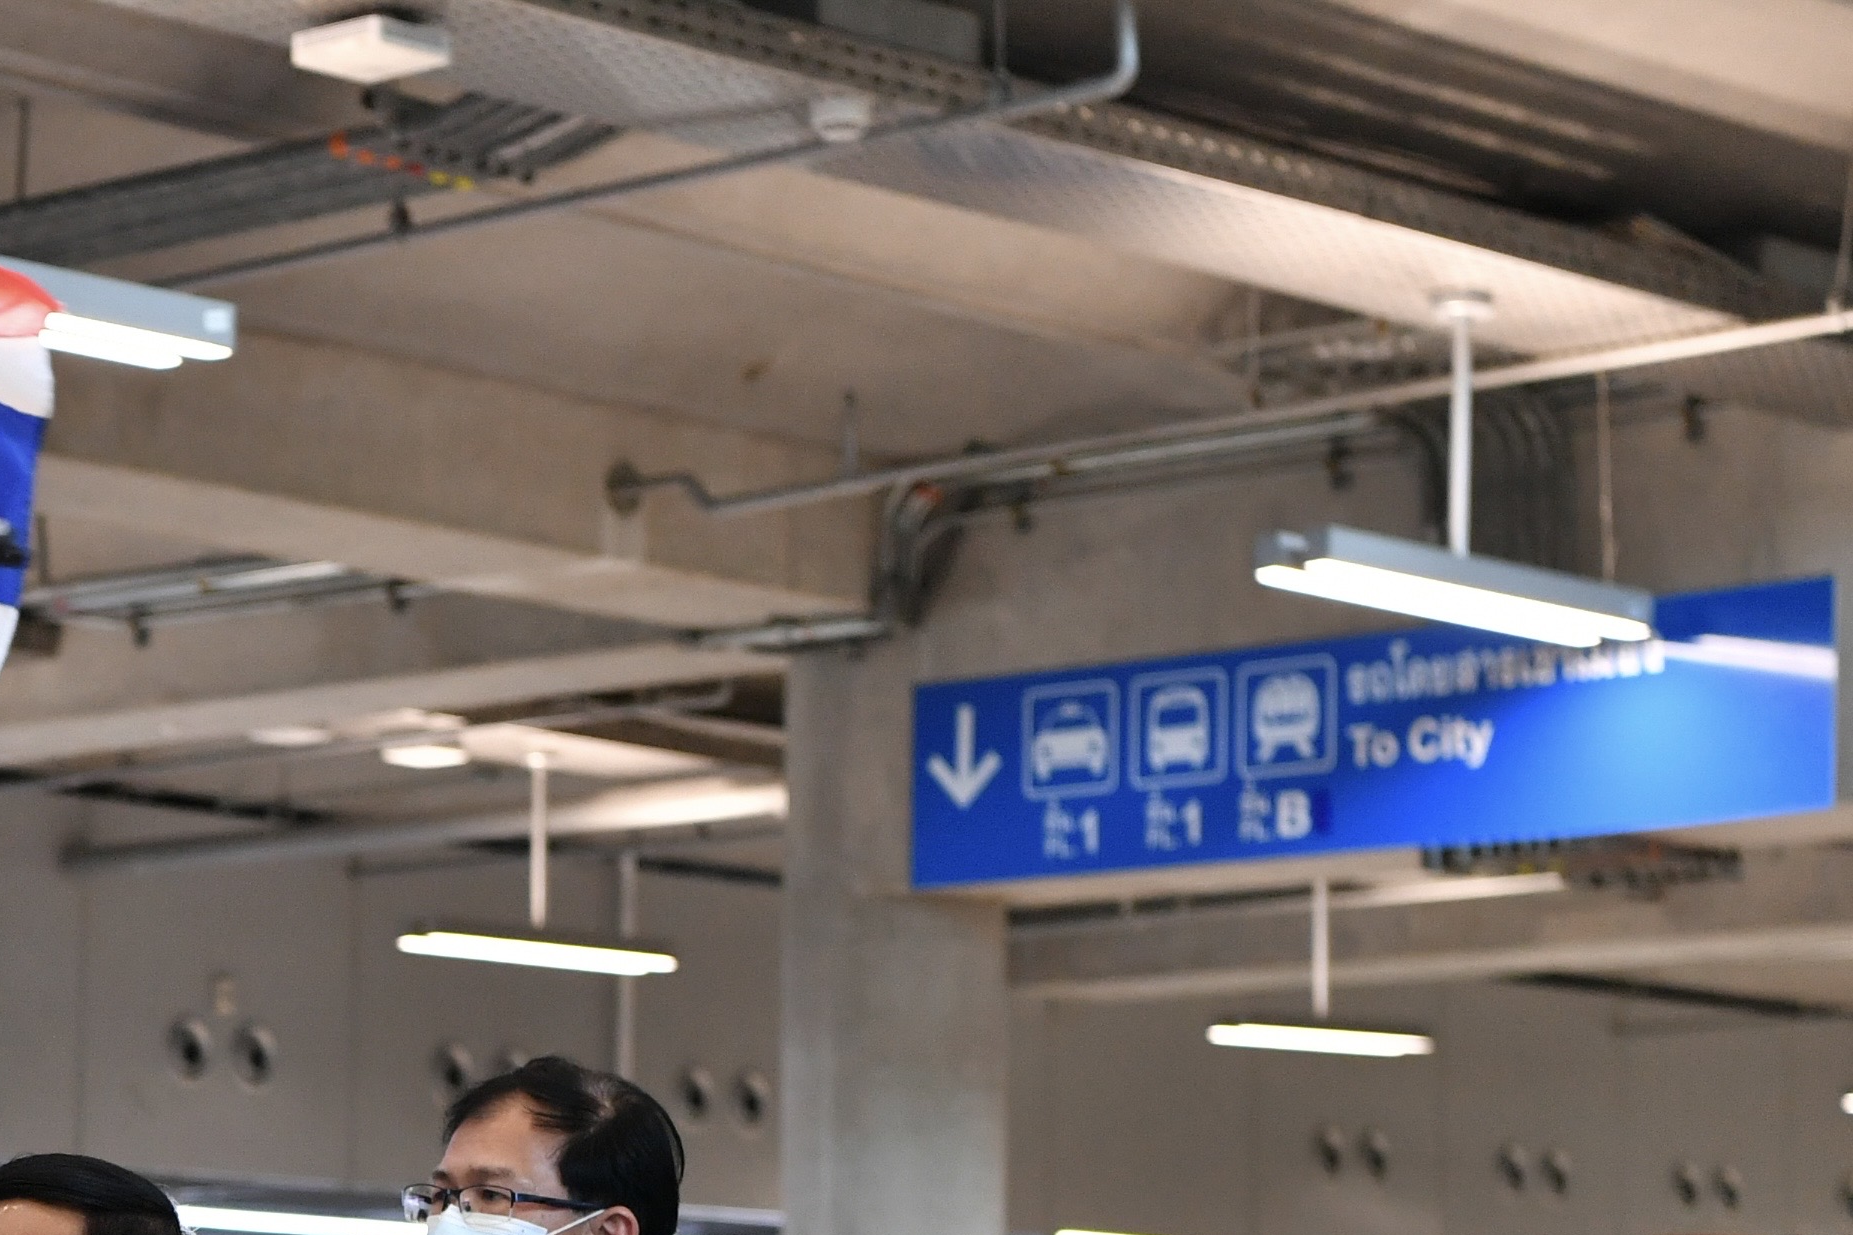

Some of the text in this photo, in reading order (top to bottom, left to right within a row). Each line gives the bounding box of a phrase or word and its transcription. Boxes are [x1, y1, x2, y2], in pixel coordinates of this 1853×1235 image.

[1350, 714, 1495, 769] To City
[1079, 806, 1100, 854] 1
[1184, 798, 1203, 847] 1
[1275, 788, 1312, 840] B
